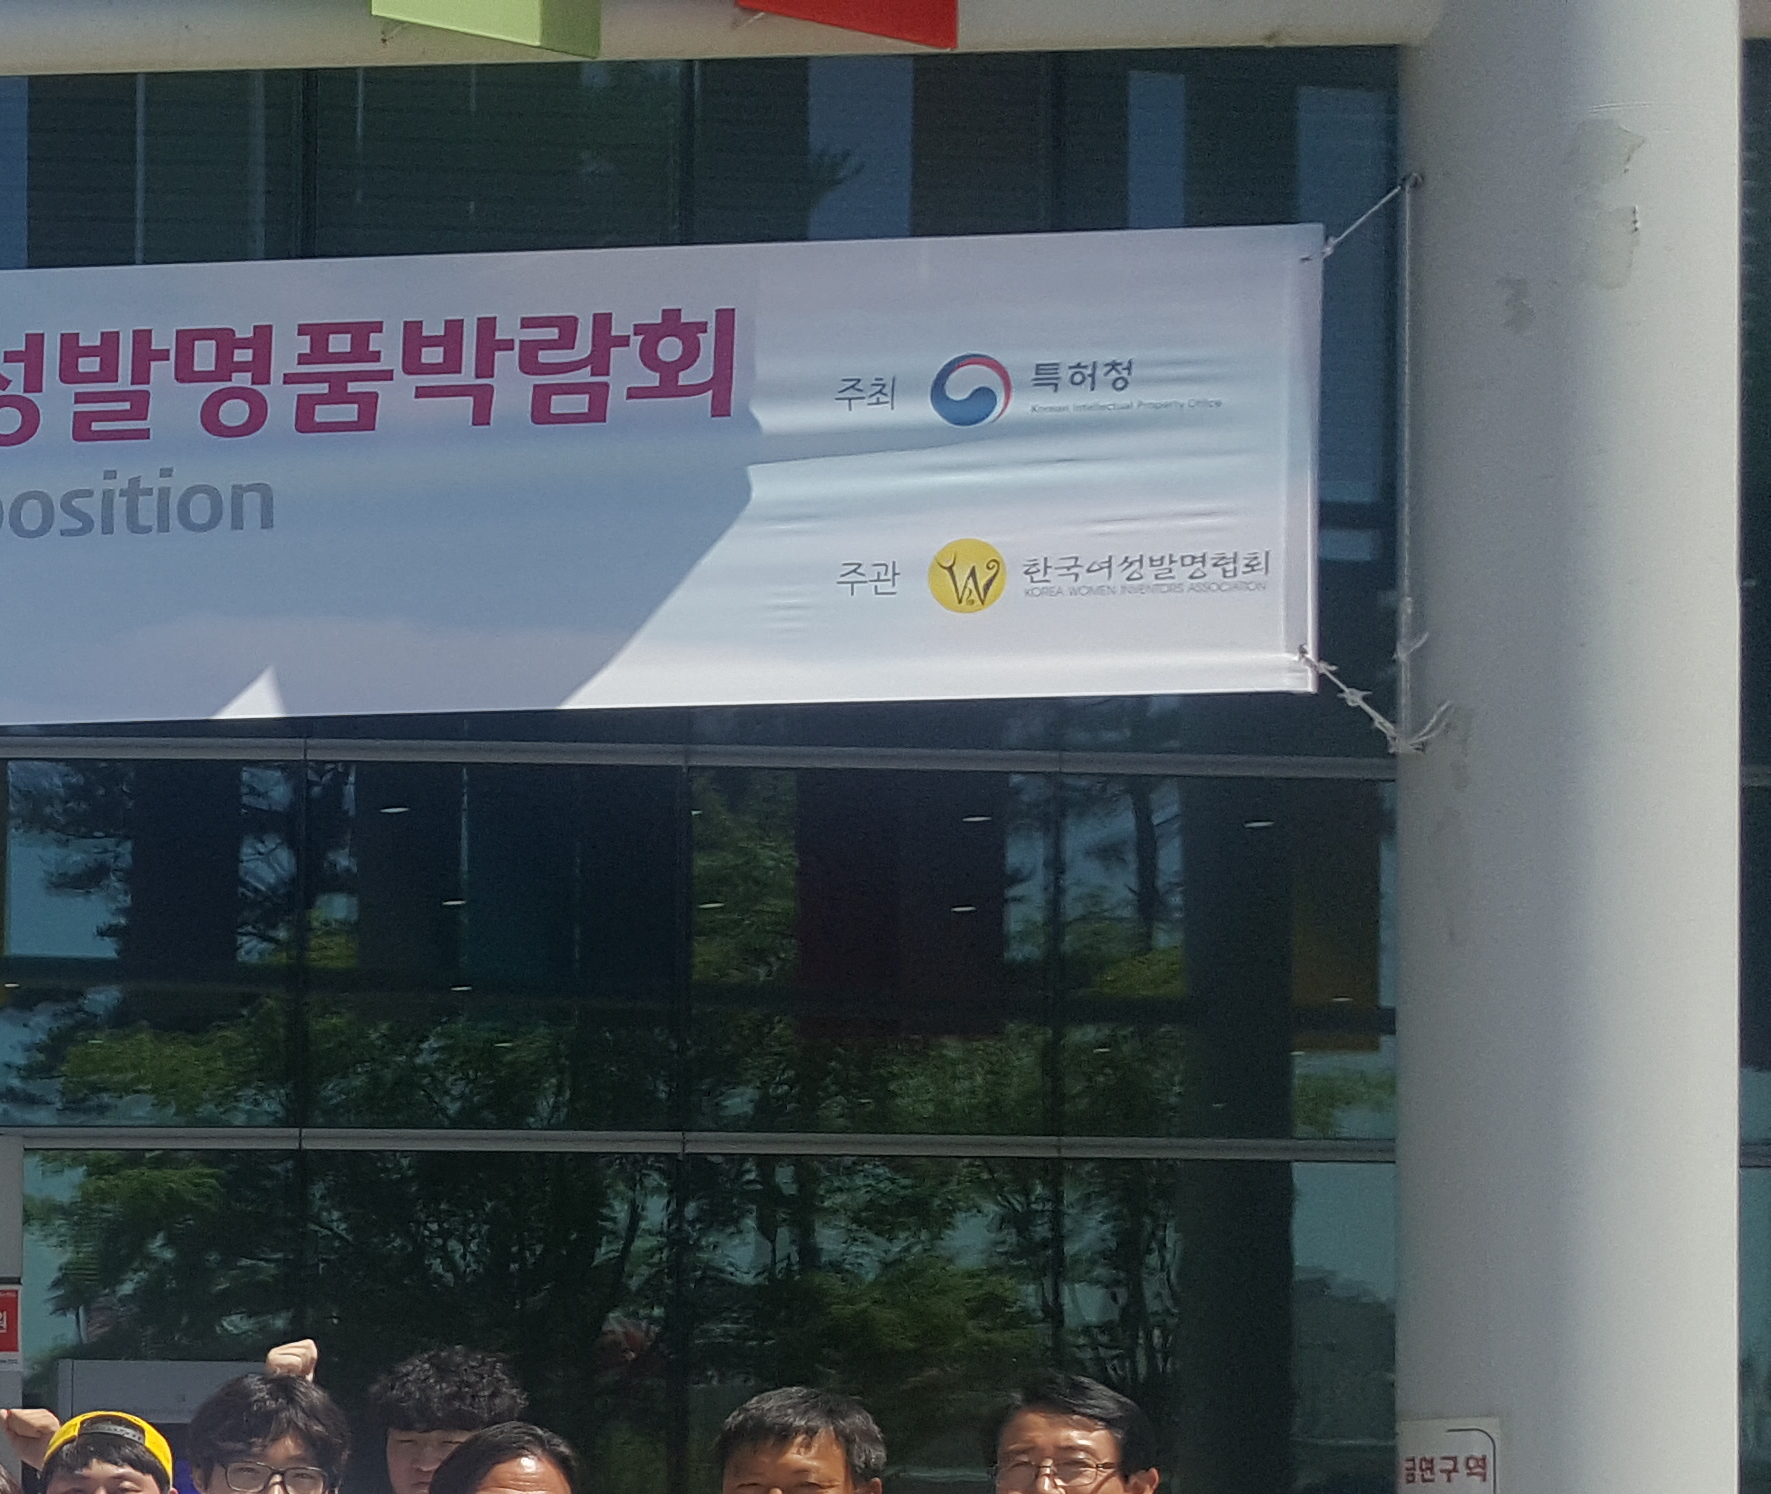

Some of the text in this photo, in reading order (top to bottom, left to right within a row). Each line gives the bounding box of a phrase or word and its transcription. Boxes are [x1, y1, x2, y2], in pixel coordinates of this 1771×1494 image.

[835, 358, 1134, 411] 주최 특허청
[836, 550, 1274, 597] 주관 한국여성발명협회
